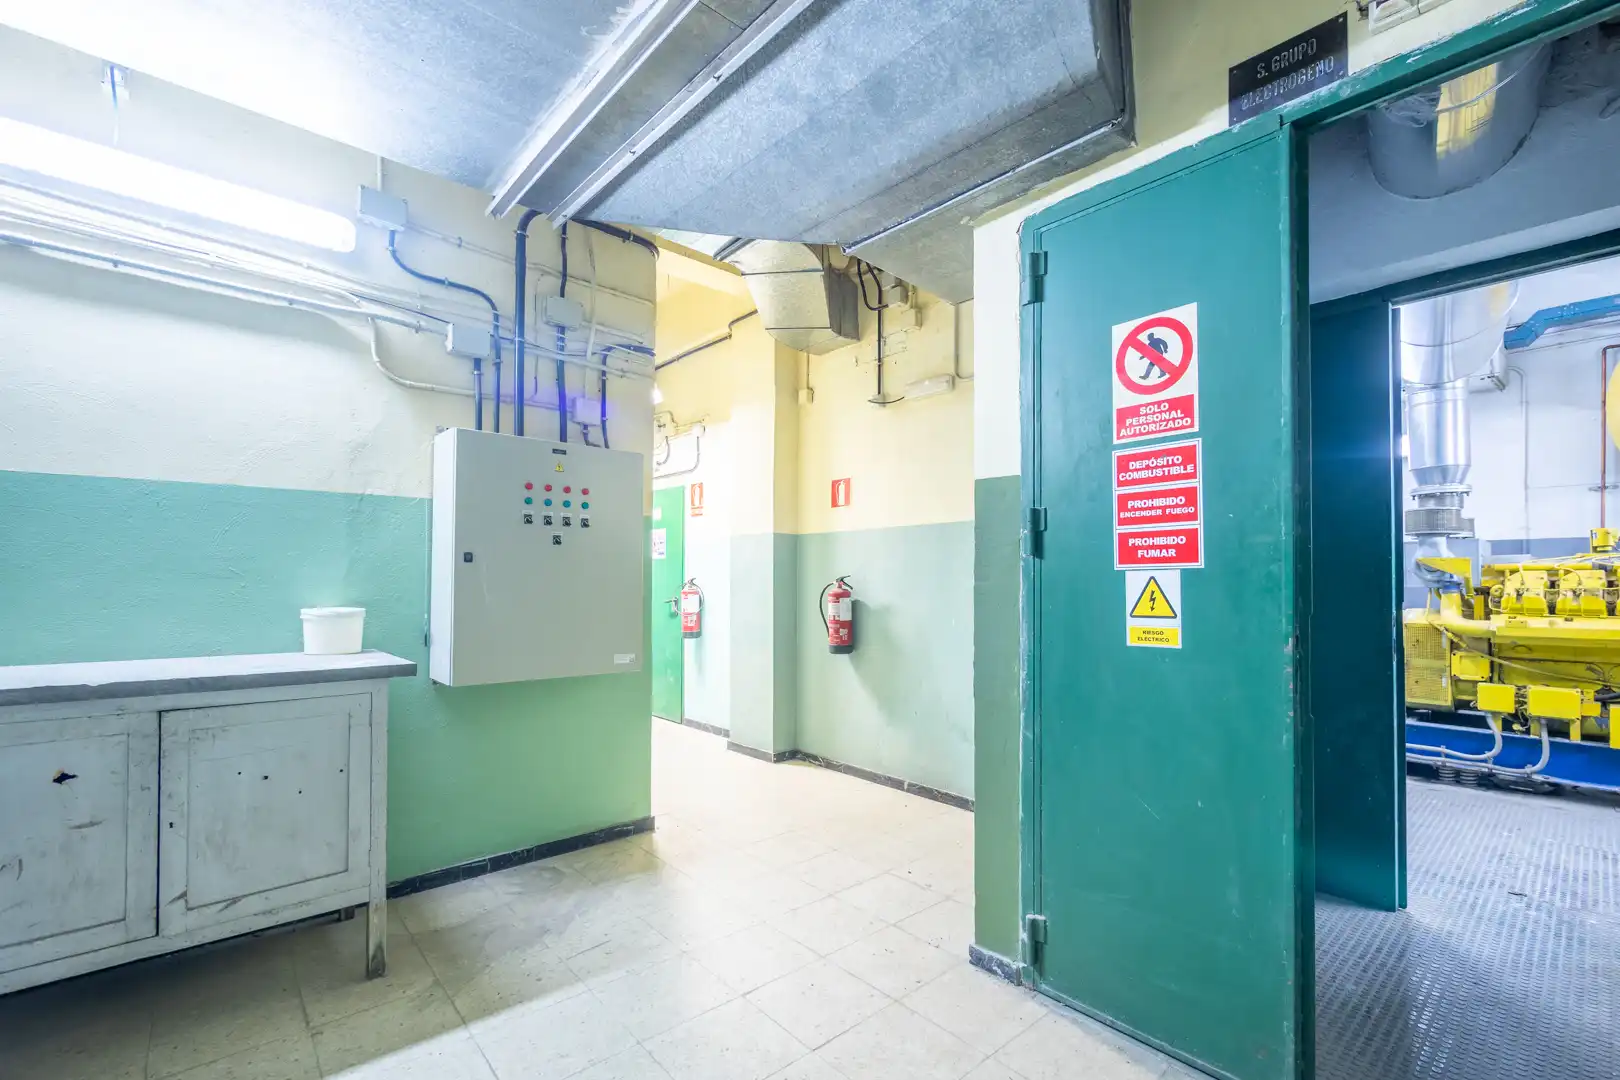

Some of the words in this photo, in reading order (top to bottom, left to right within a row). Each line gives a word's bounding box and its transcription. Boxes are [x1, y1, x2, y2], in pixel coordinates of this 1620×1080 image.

[1257, 62, 1268, 79] S.
[1271, 38, 1317, 72] GRUPO
[1139, 402, 1169, 415] SOLO
[1125, 409, 1184, 427] PERSONAL
[1120, 417, 1192, 436] AUTORIZADO
[1128, 455, 1182, 470] DEPÓSITO
[1119, 464, 1194, 481] COMBUSTIBLE
[1127, 496, 1186, 509] PROHIBIDO
[1119, 509, 1163, 519] ENCENDER
[1165, 506, 1195, 515] FUEGO
[1128, 535, 1187, 547] PROHIBIDO
[1137, 548, 1177, 558] FUMAR
